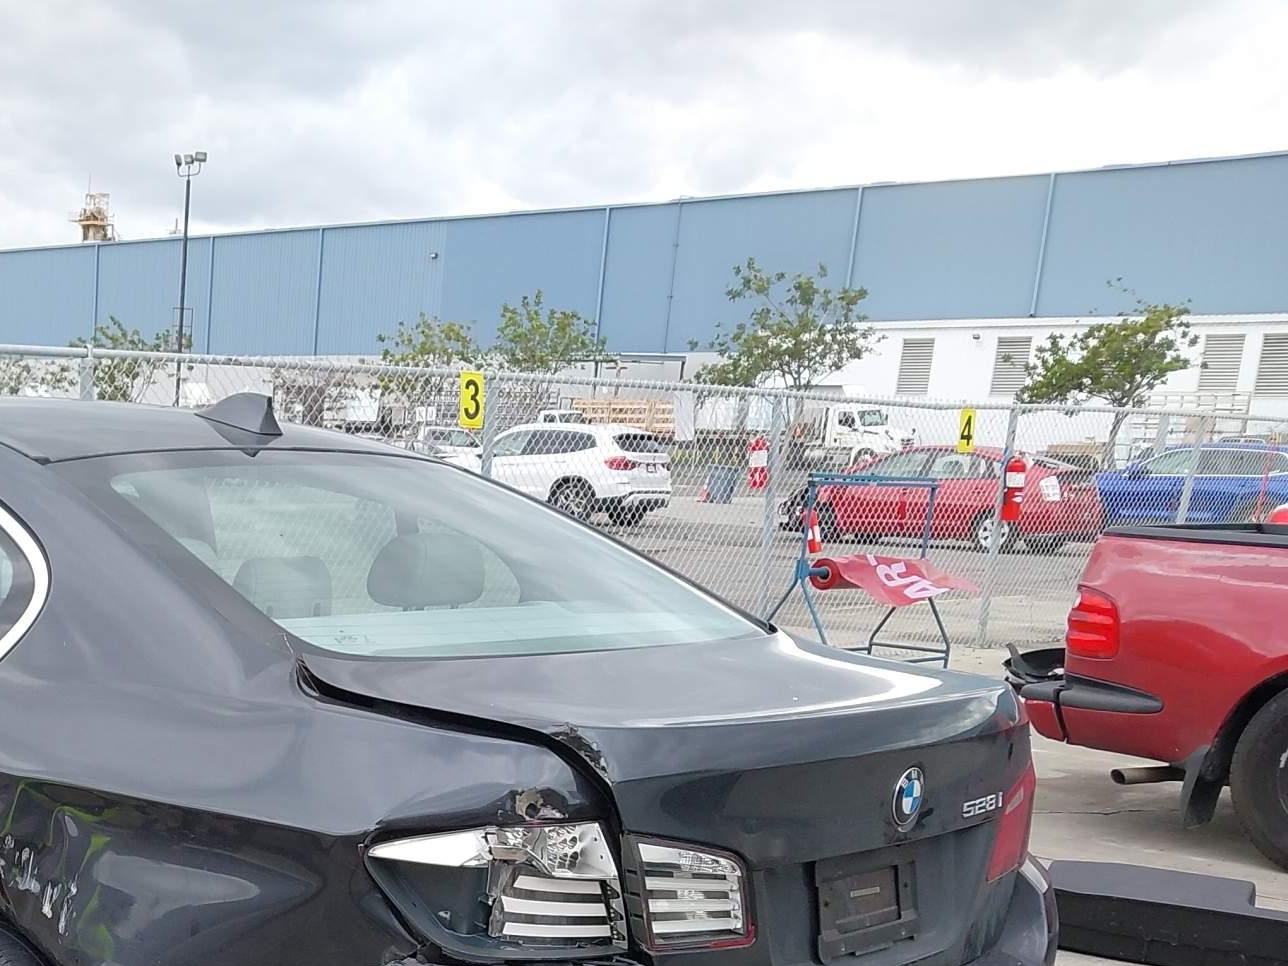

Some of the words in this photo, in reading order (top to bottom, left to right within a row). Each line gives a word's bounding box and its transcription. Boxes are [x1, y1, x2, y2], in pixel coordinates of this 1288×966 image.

[464, 379, 480, 420] 3
[960, 415, 973, 446] 4
[962, 791, 1004, 818] 528i
